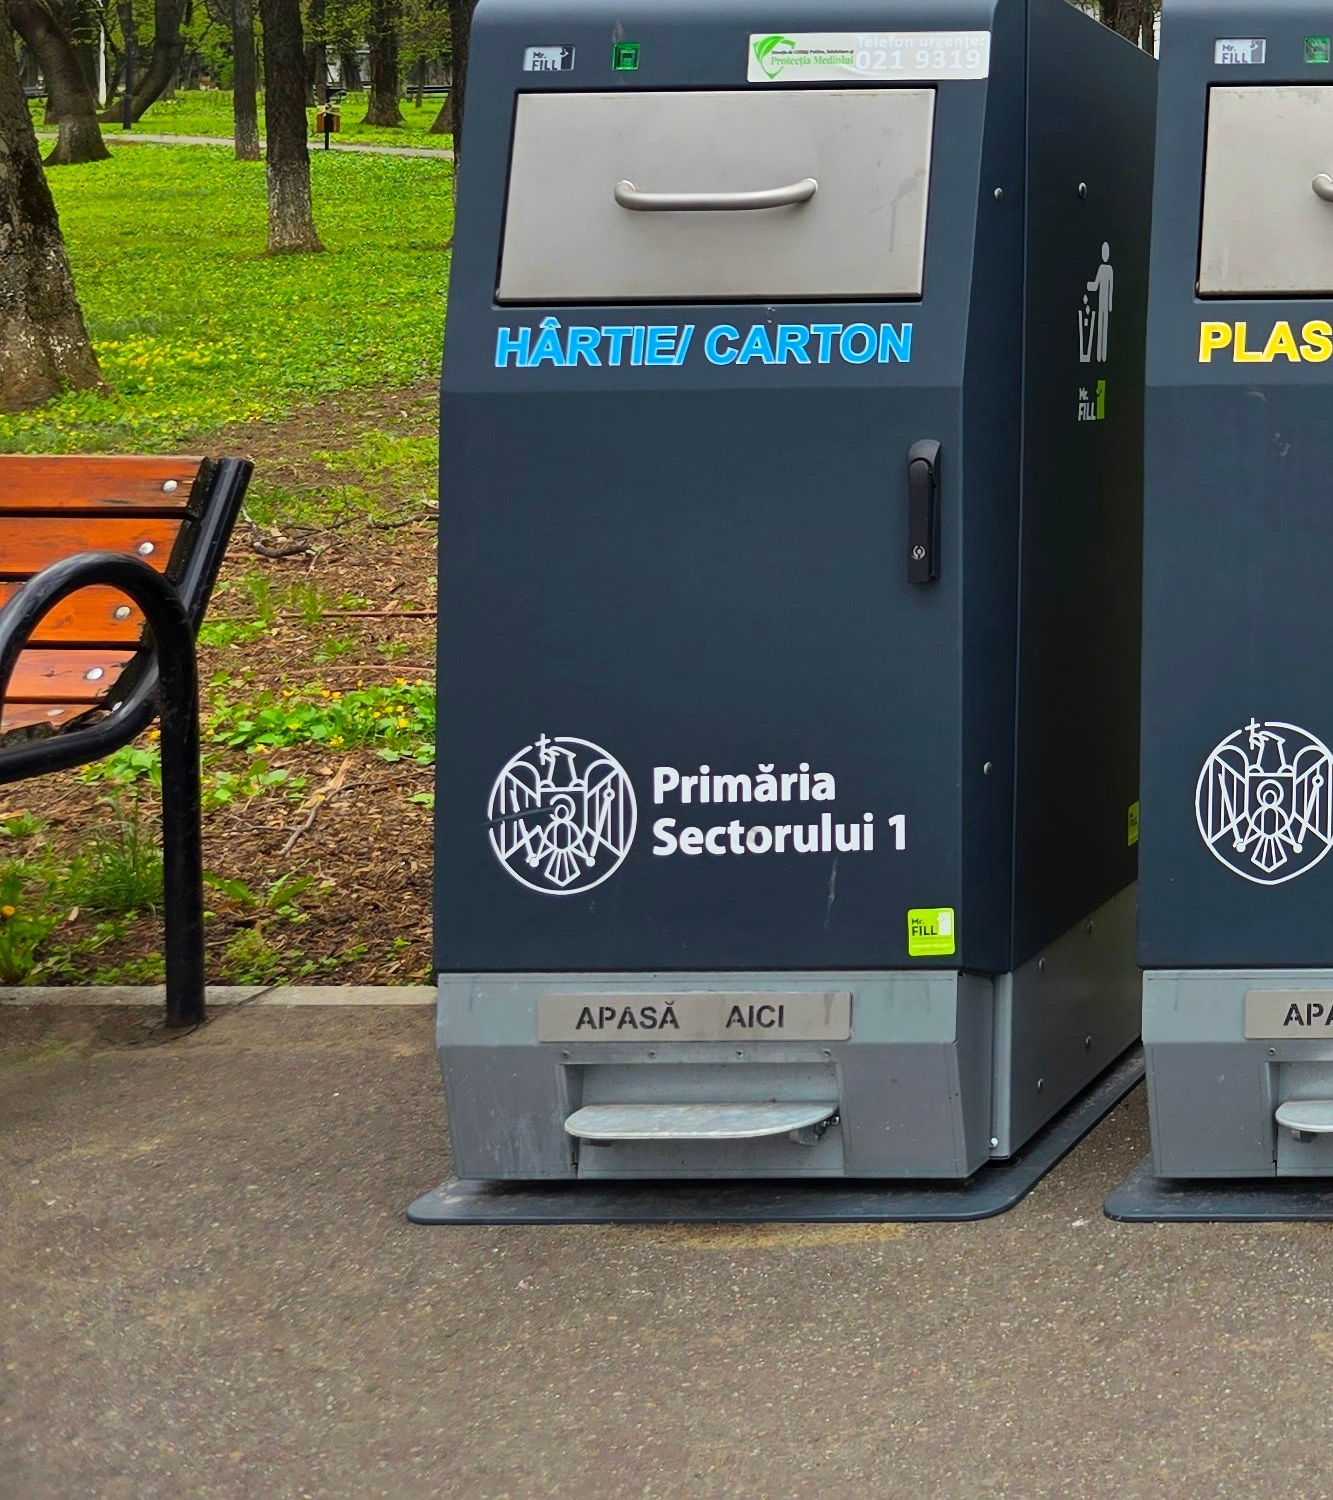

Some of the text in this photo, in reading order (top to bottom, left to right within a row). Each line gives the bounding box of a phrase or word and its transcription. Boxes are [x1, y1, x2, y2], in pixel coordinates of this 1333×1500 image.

[857, 36, 913, 47] Telefon
[532, 60, 558, 70] FILL
[856, 49, 981, 70] 021 9319
[1222, 53, 1247, 63] FILL
[495, 316, 913, 367] HÂRTIE/ CARTON
[1078, 402, 1096, 421] FILL
[653, 762, 836, 804] Primăria
[652, 812, 908, 857] Sectorului 1
[911, 925, 937, 936] FILL
[575, 1000, 785, 1031] APASĂ AICI
